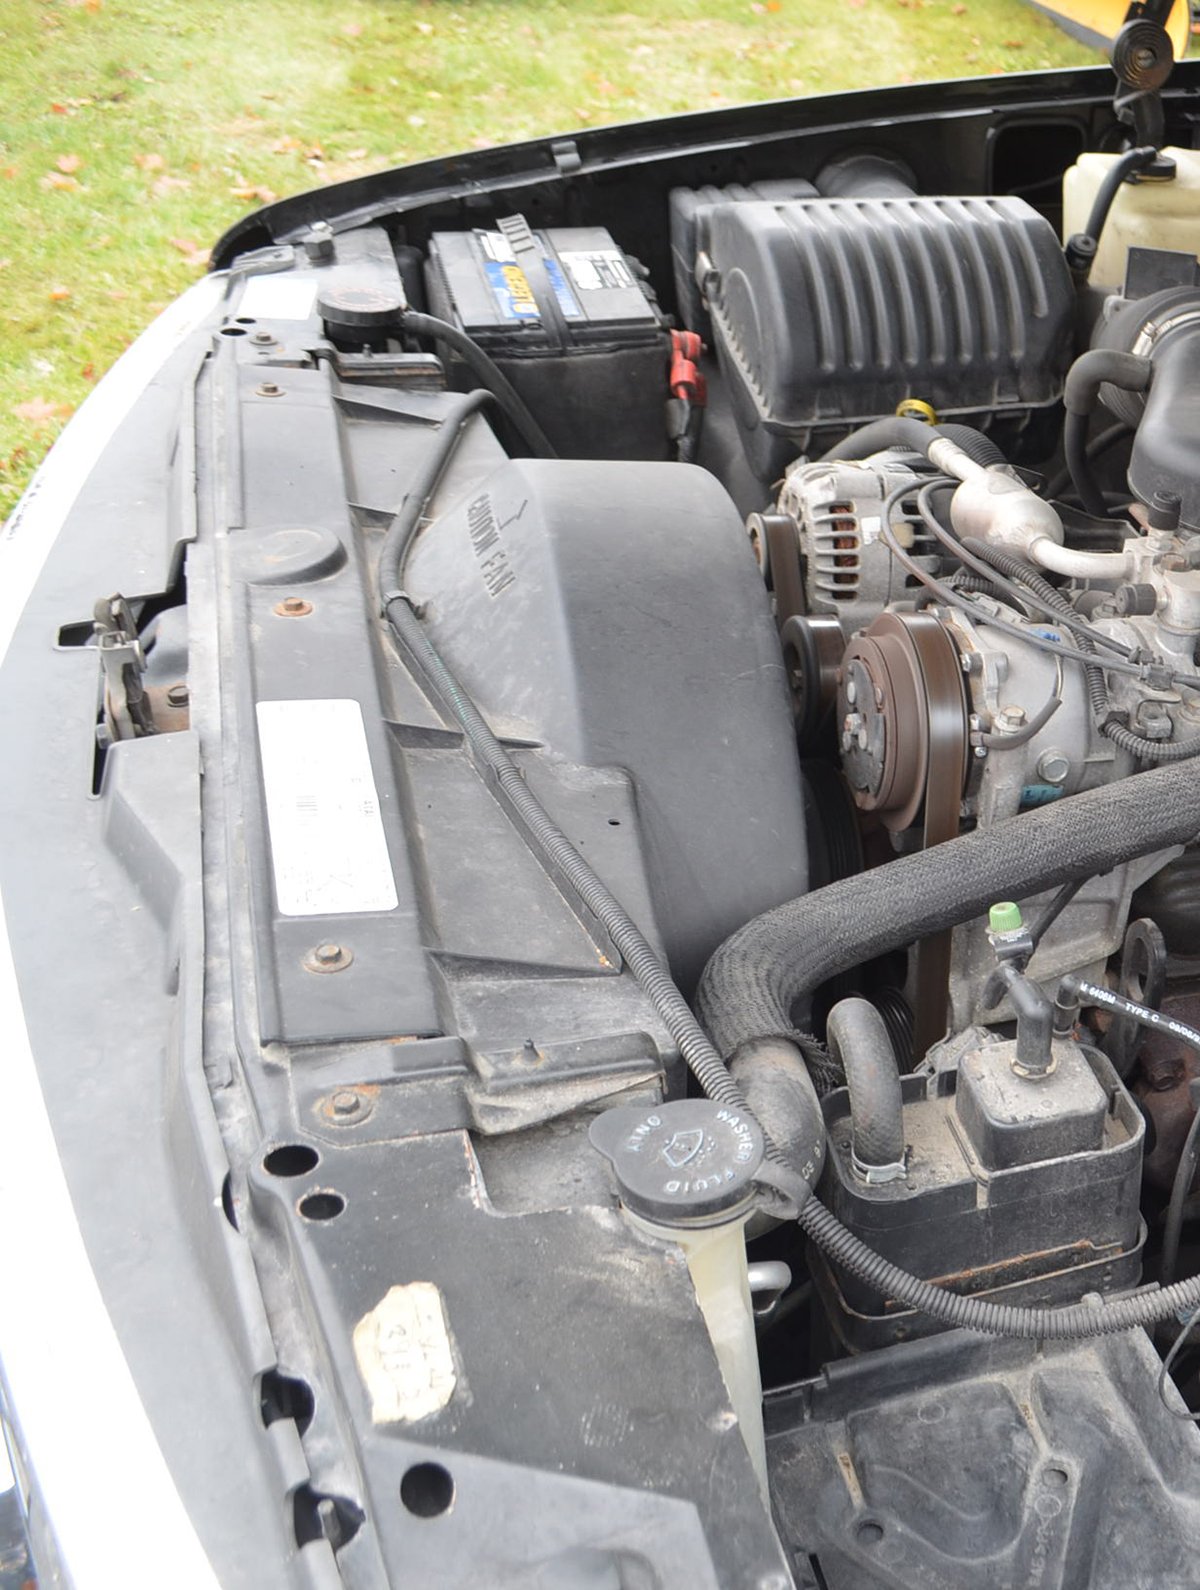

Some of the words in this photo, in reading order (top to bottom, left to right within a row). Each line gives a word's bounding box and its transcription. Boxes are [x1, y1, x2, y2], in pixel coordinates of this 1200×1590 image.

[480, 550, 516, 597] FAN
[1125, 1002, 1149, 1020] TYPE
[1151, 1012, 1160, 1023] C
[625, 1114, 662, 1153] ONLY
[716, 1109, 755, 1163] WASHER
[665, 1168, 736, 1193] FLUID
